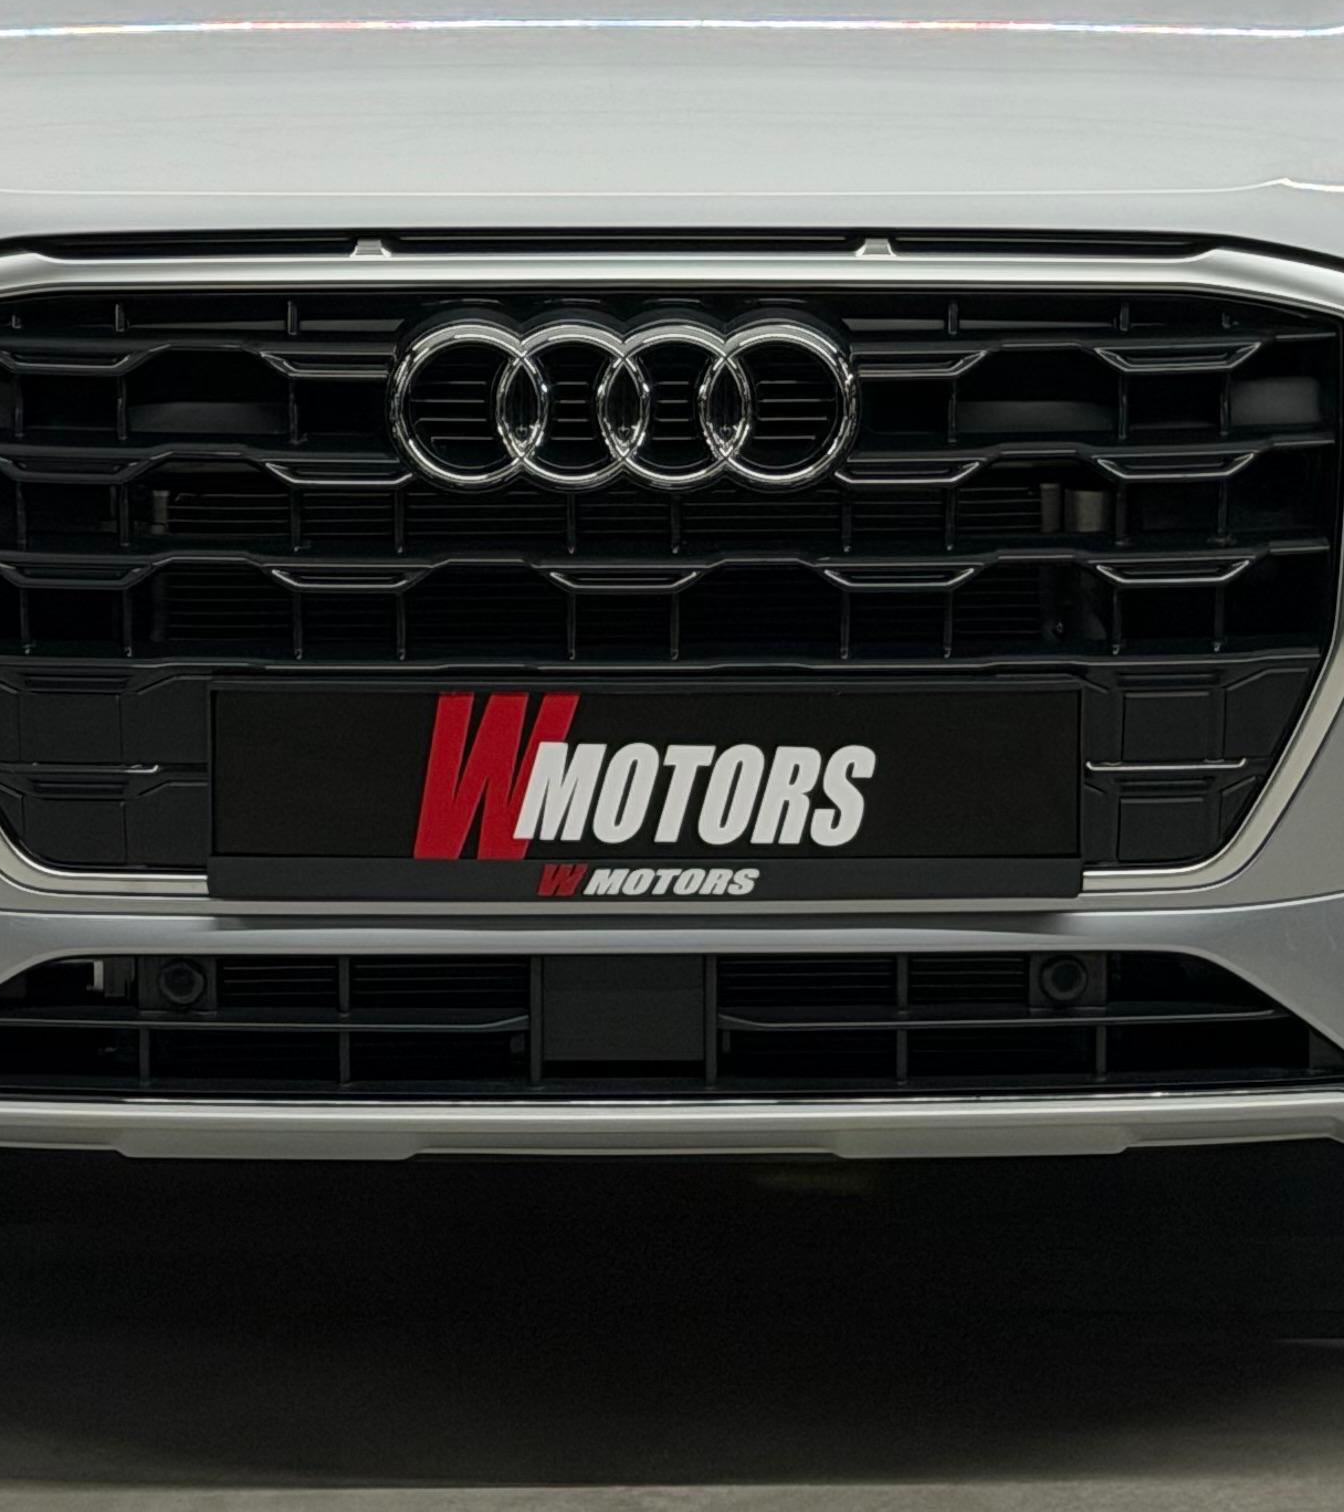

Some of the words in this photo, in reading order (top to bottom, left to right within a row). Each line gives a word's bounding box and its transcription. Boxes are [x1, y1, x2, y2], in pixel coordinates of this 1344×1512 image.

[512, 740, 877, 847] MOTORS
[537, 863, 588, 897] W
[582, 868, 761, 897] MOTORS
